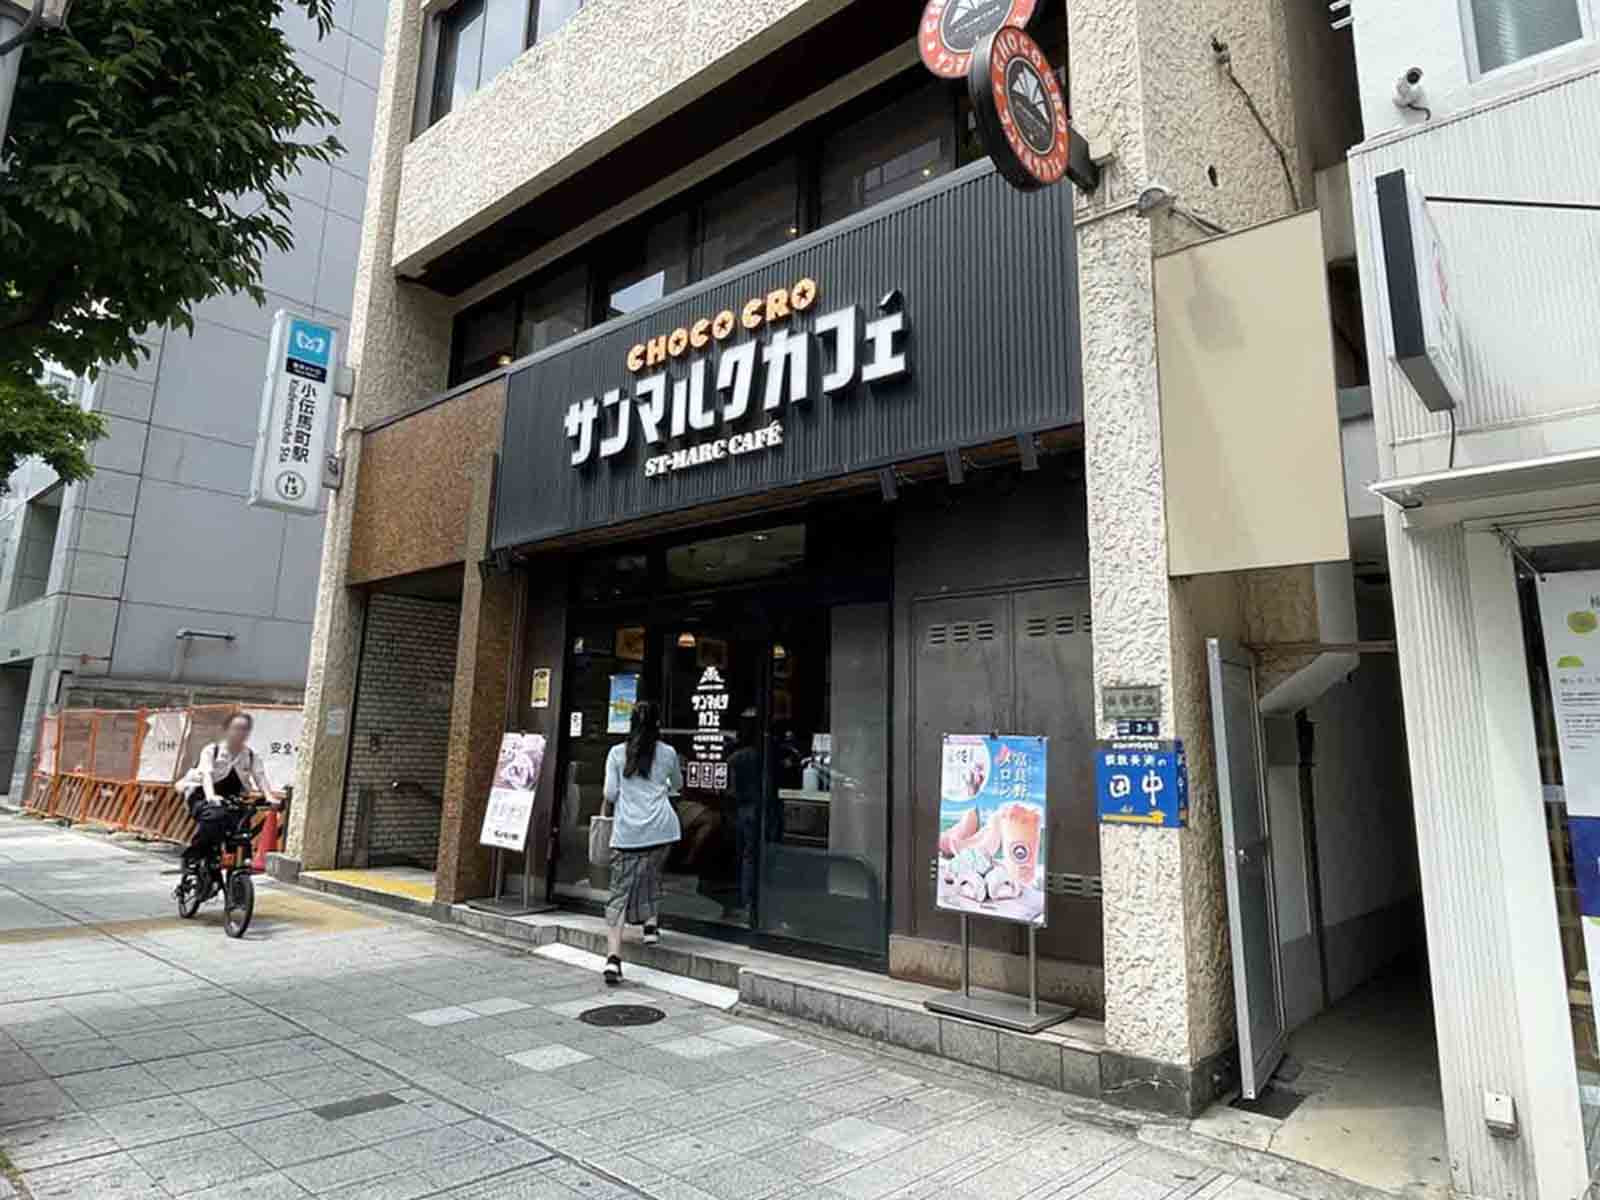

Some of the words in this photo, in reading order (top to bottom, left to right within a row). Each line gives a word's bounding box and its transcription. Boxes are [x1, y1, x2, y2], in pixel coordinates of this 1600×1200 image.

[627, 310, 735, 372] CHOCO
[741, 277, 817, 329] CRO
[563, 289, 906, 466] サンマルクカフェ
[645, 439, 728, 477] ST-MARC
[728, 420, 784, 455] CAFÉ
